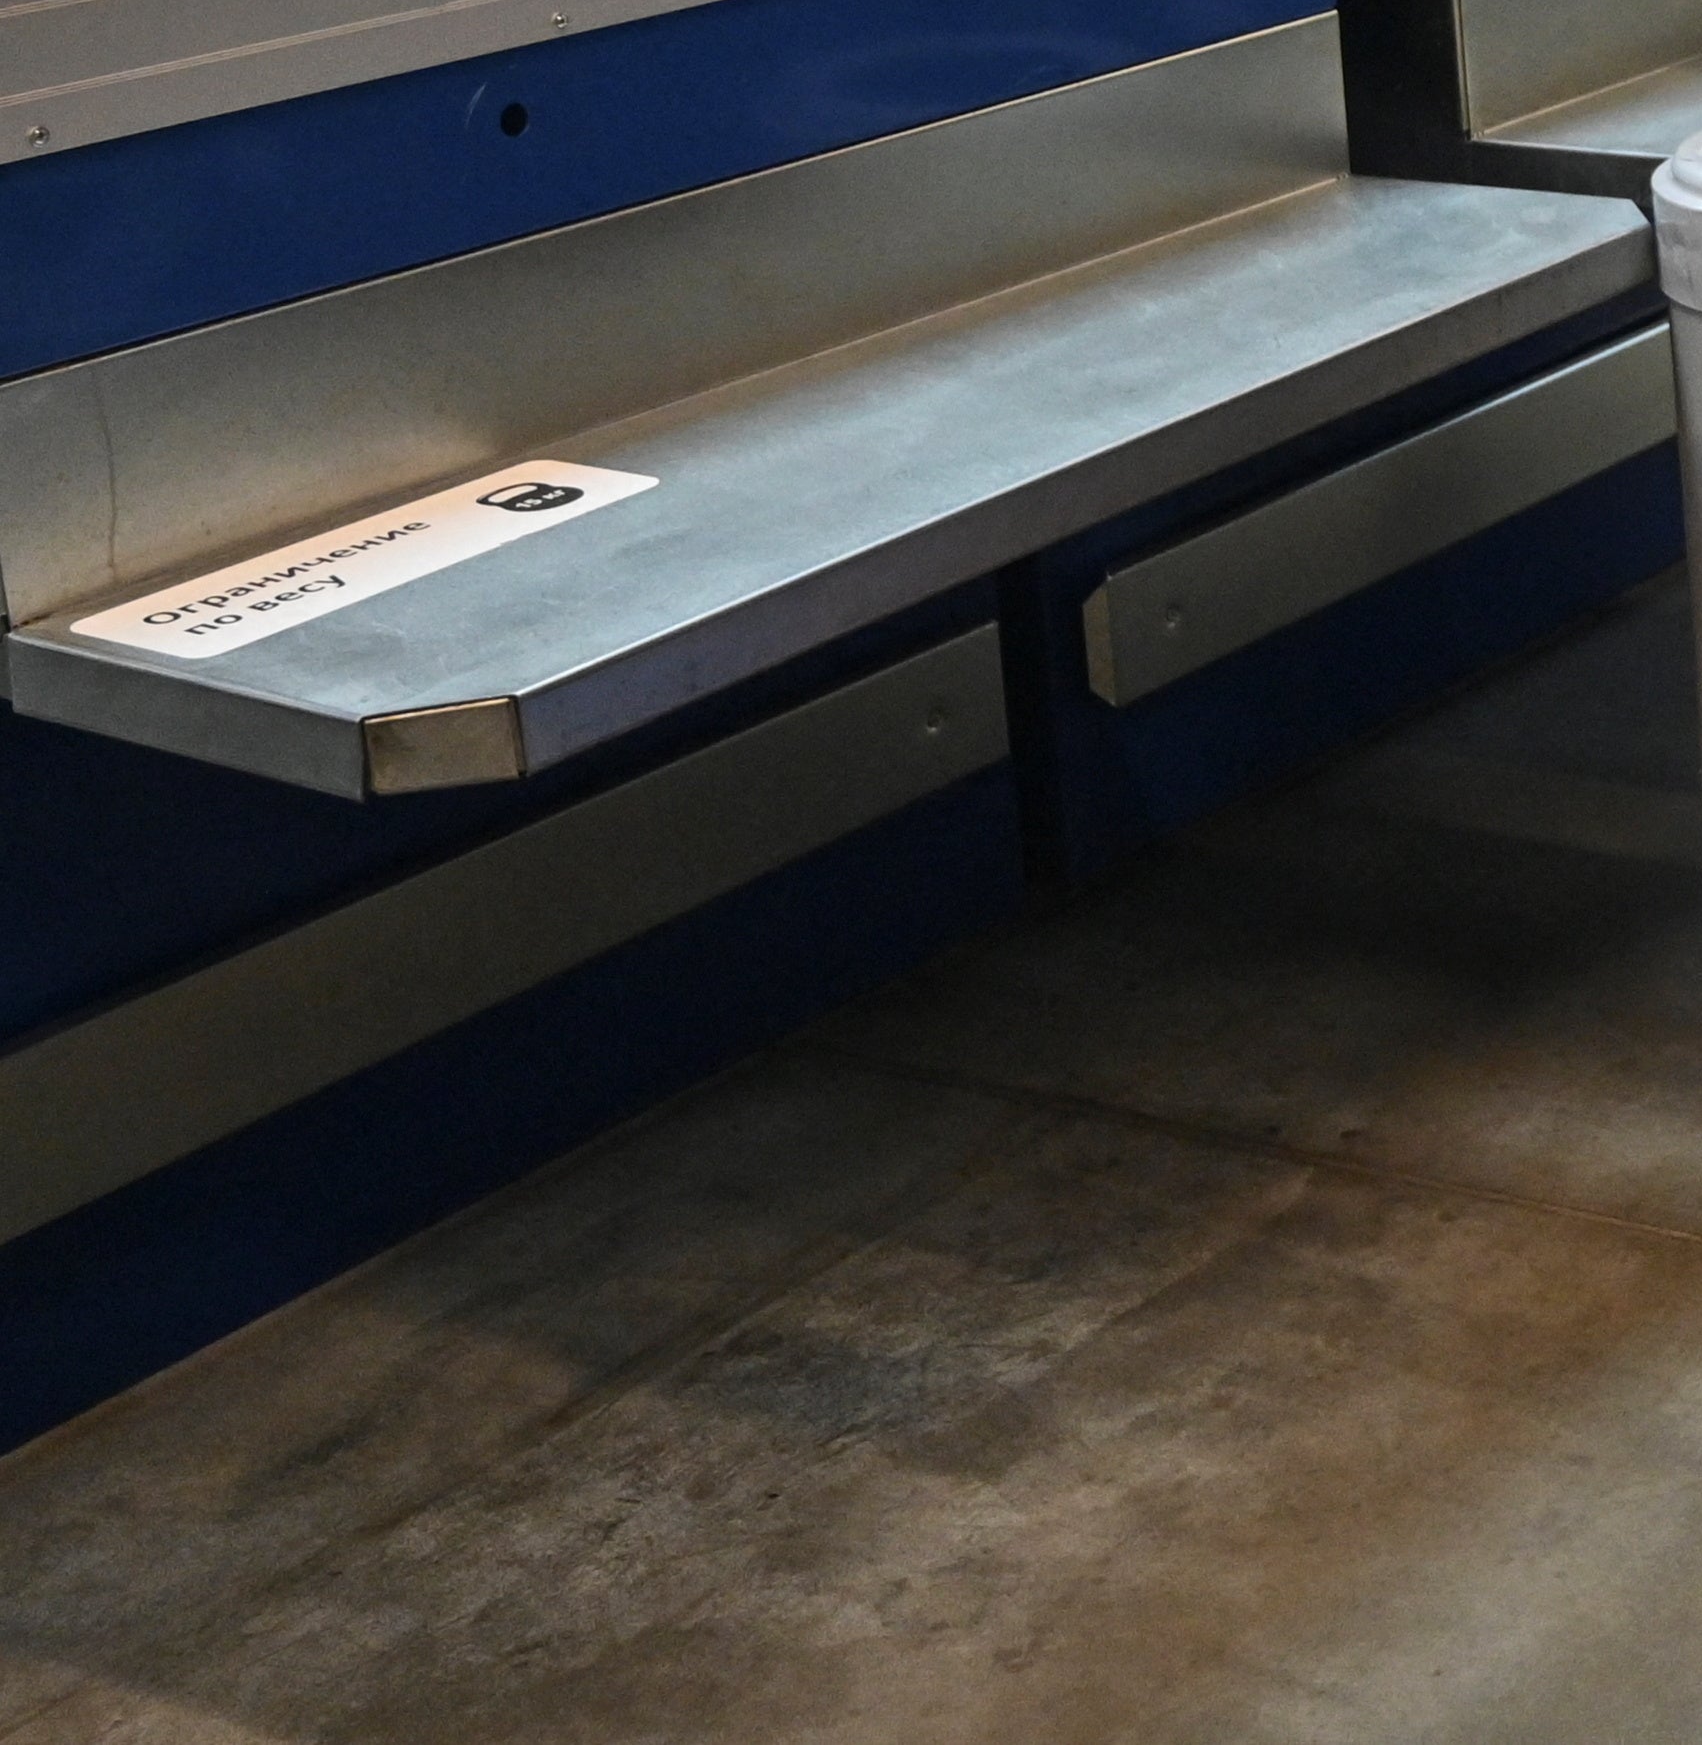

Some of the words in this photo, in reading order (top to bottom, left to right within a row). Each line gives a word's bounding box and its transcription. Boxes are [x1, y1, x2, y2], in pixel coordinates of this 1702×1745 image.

[142, 520, 431, 625] Ограничение
[514, 497, 543, 509] 15
[184, 613, 243, 635] по
[249, 574, 347, 612] весу
